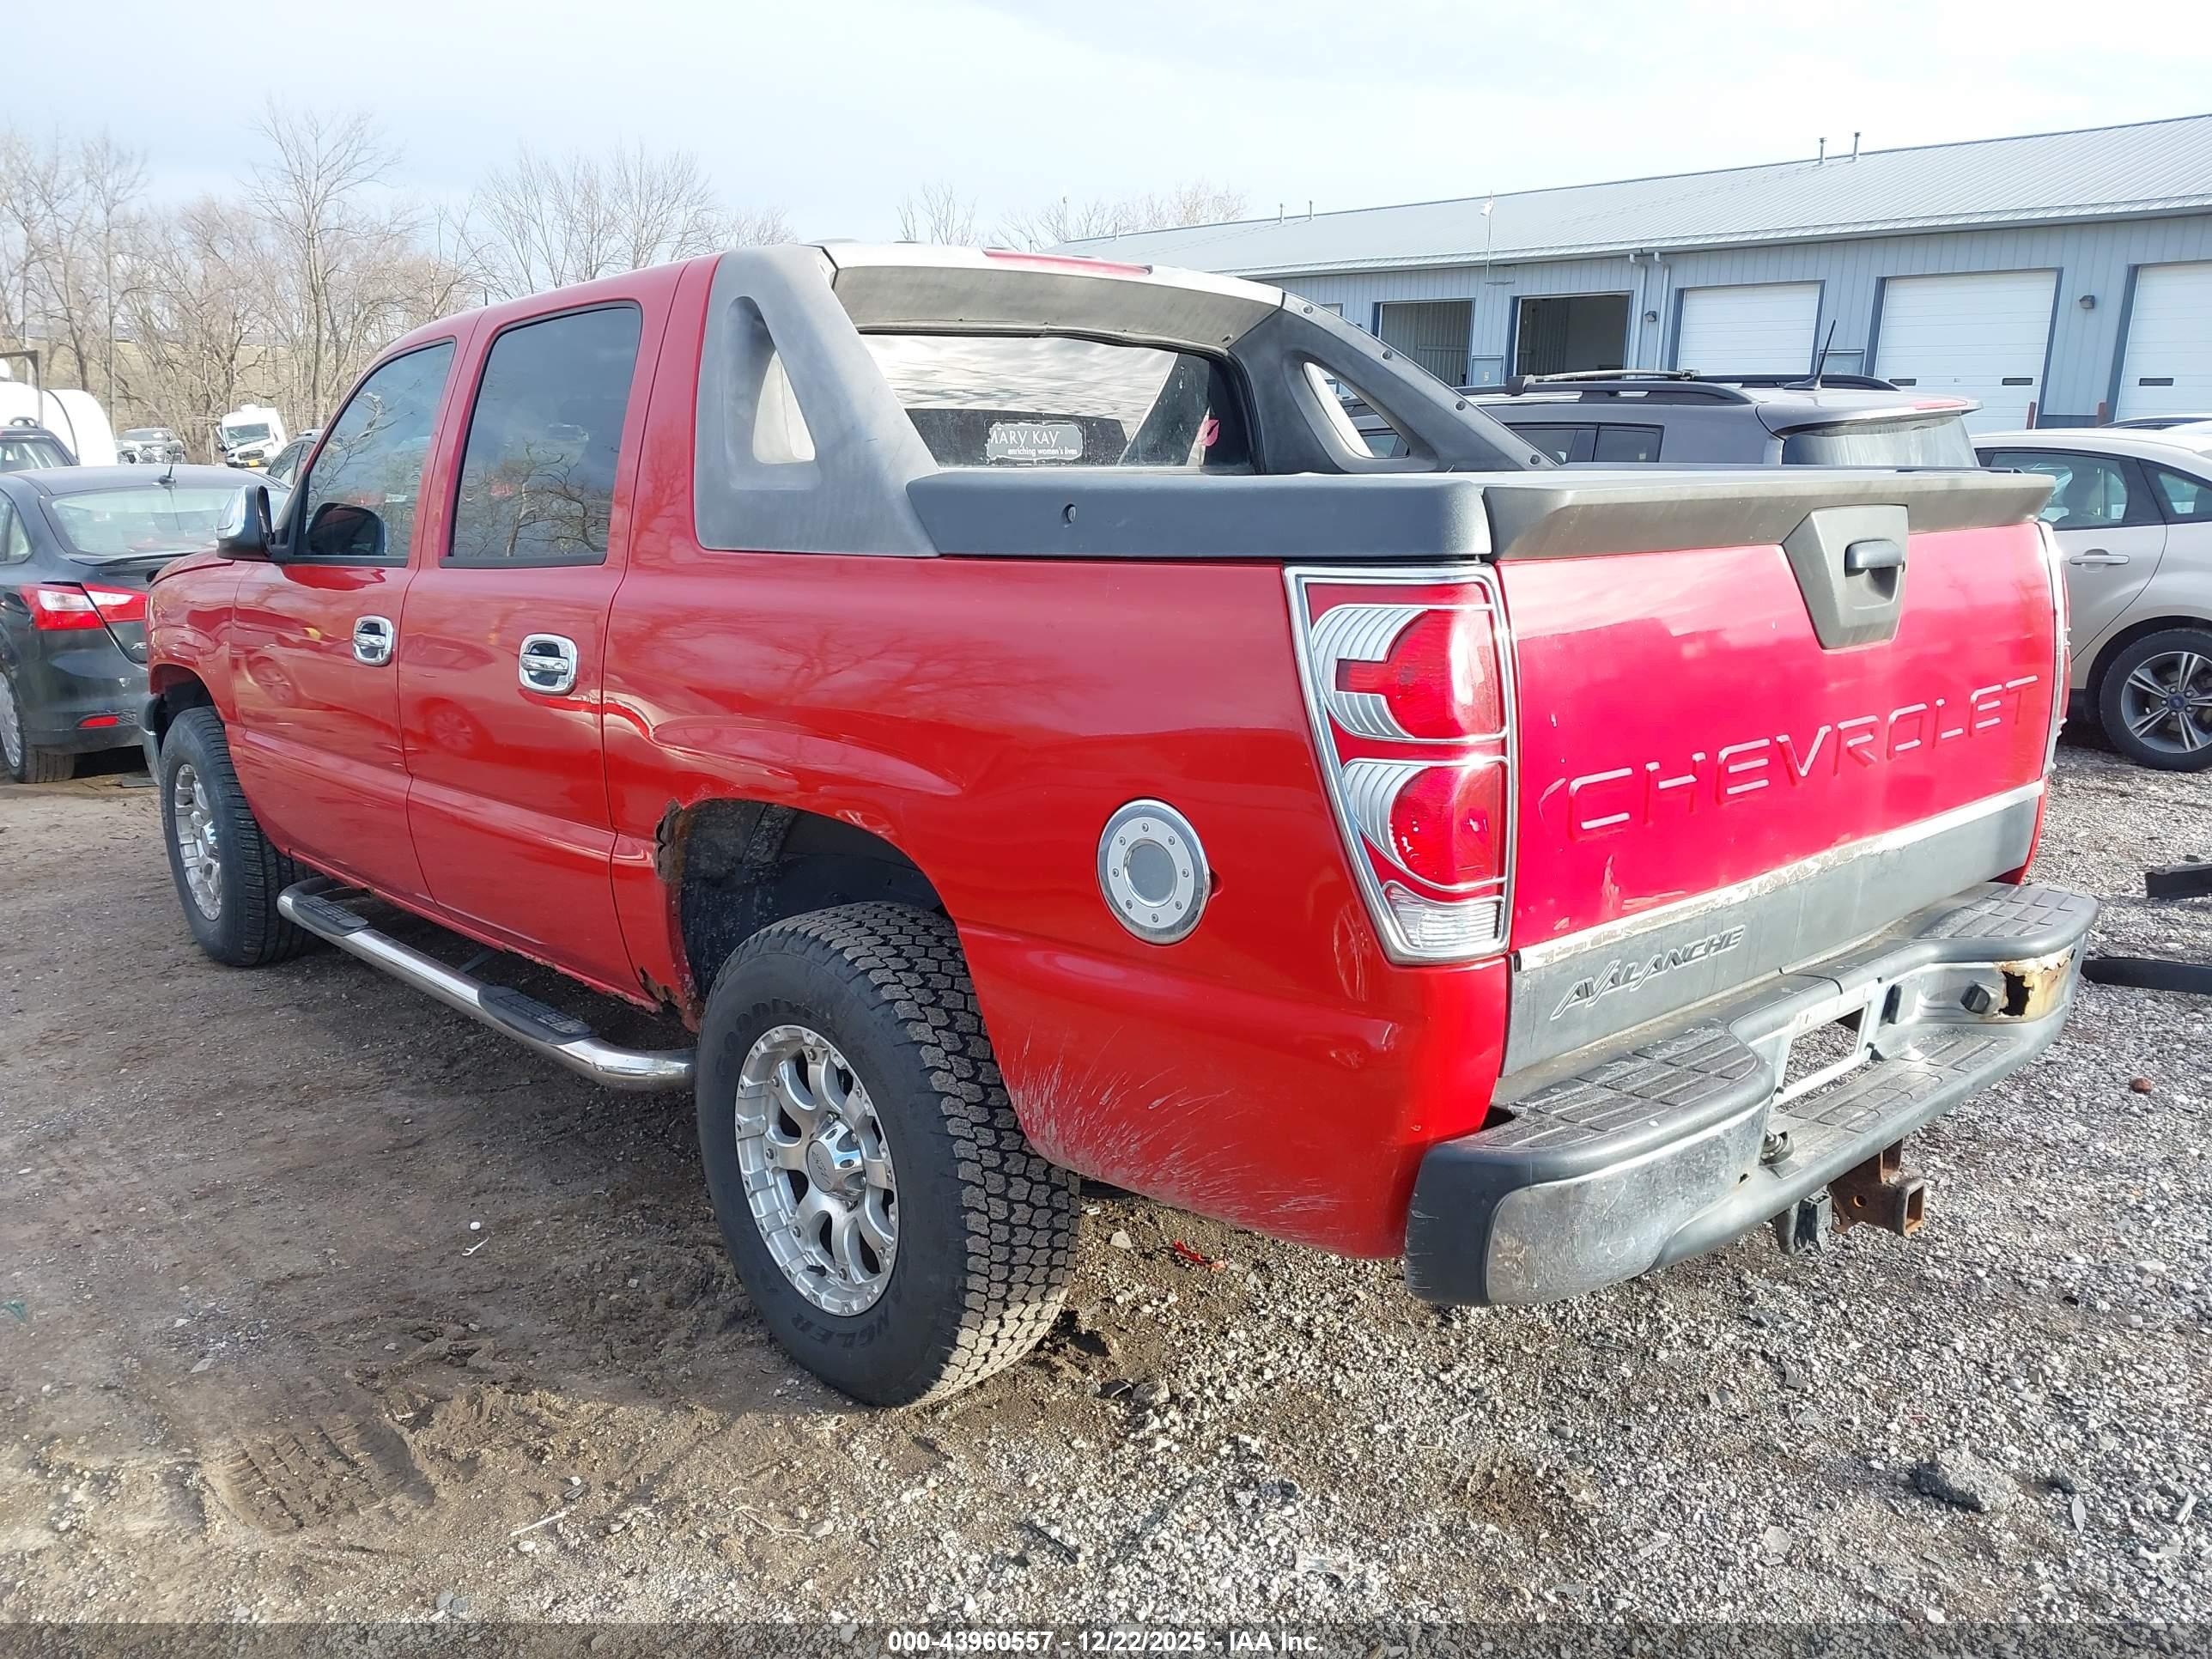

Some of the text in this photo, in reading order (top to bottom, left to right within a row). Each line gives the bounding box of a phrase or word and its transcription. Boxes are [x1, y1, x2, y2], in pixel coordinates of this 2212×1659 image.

[990, 430, 1060, 447] MARY KAY
[1007, 446, 1078, 457] enriching women's lives
[1567, 675, 2039, 842] CHEVROLET
[1549, 924, 1747, 1021] AVALANCHE
